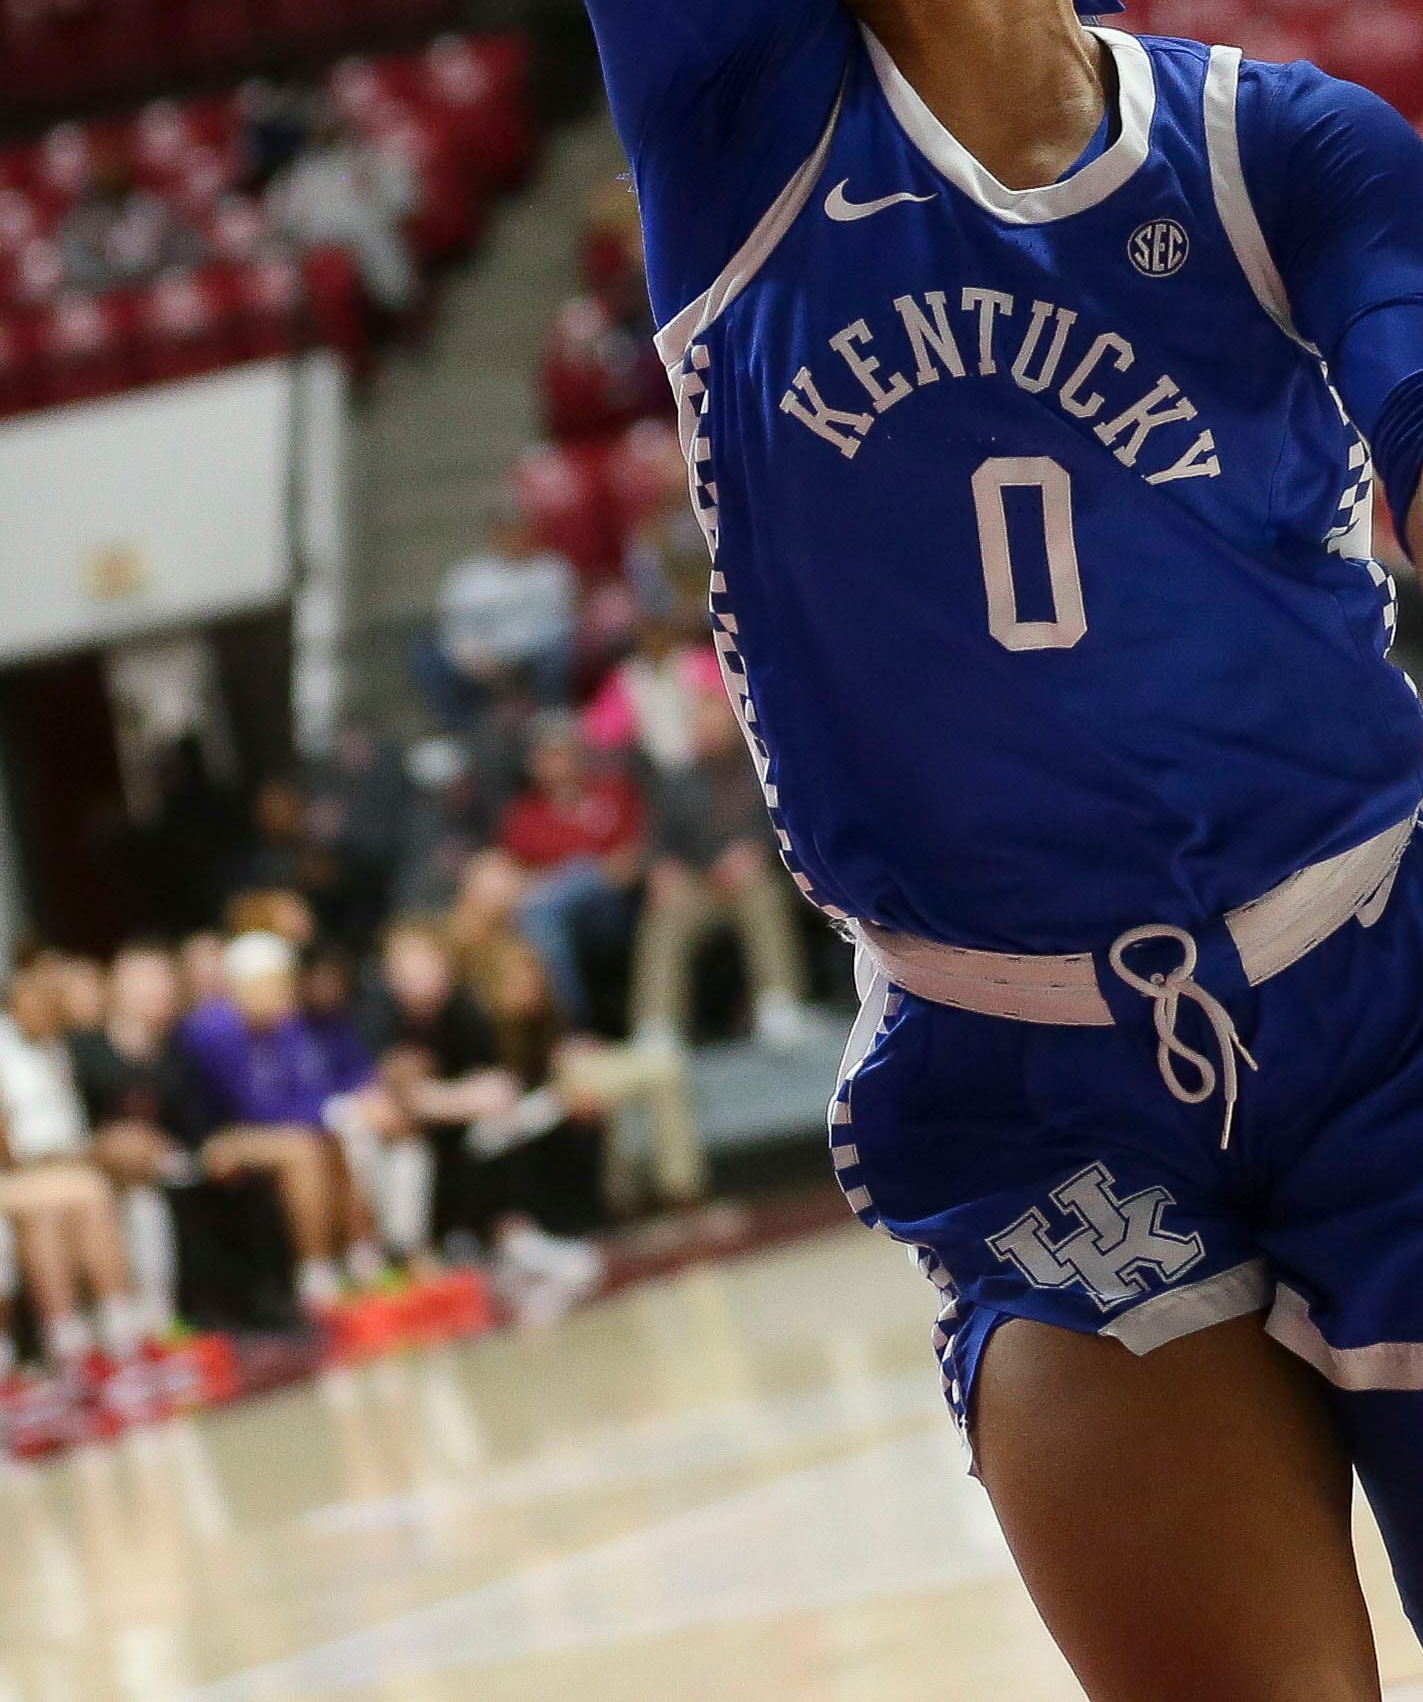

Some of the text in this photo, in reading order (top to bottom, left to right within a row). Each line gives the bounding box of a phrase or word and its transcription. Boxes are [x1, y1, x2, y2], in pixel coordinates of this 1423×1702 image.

[1134, 224, 1183, 271] SEC
[779, 287, 1221, 486] KENTUCKY
[971, 456, 1088, 652] 0
[985, 1160, 1207, 1313] UK
